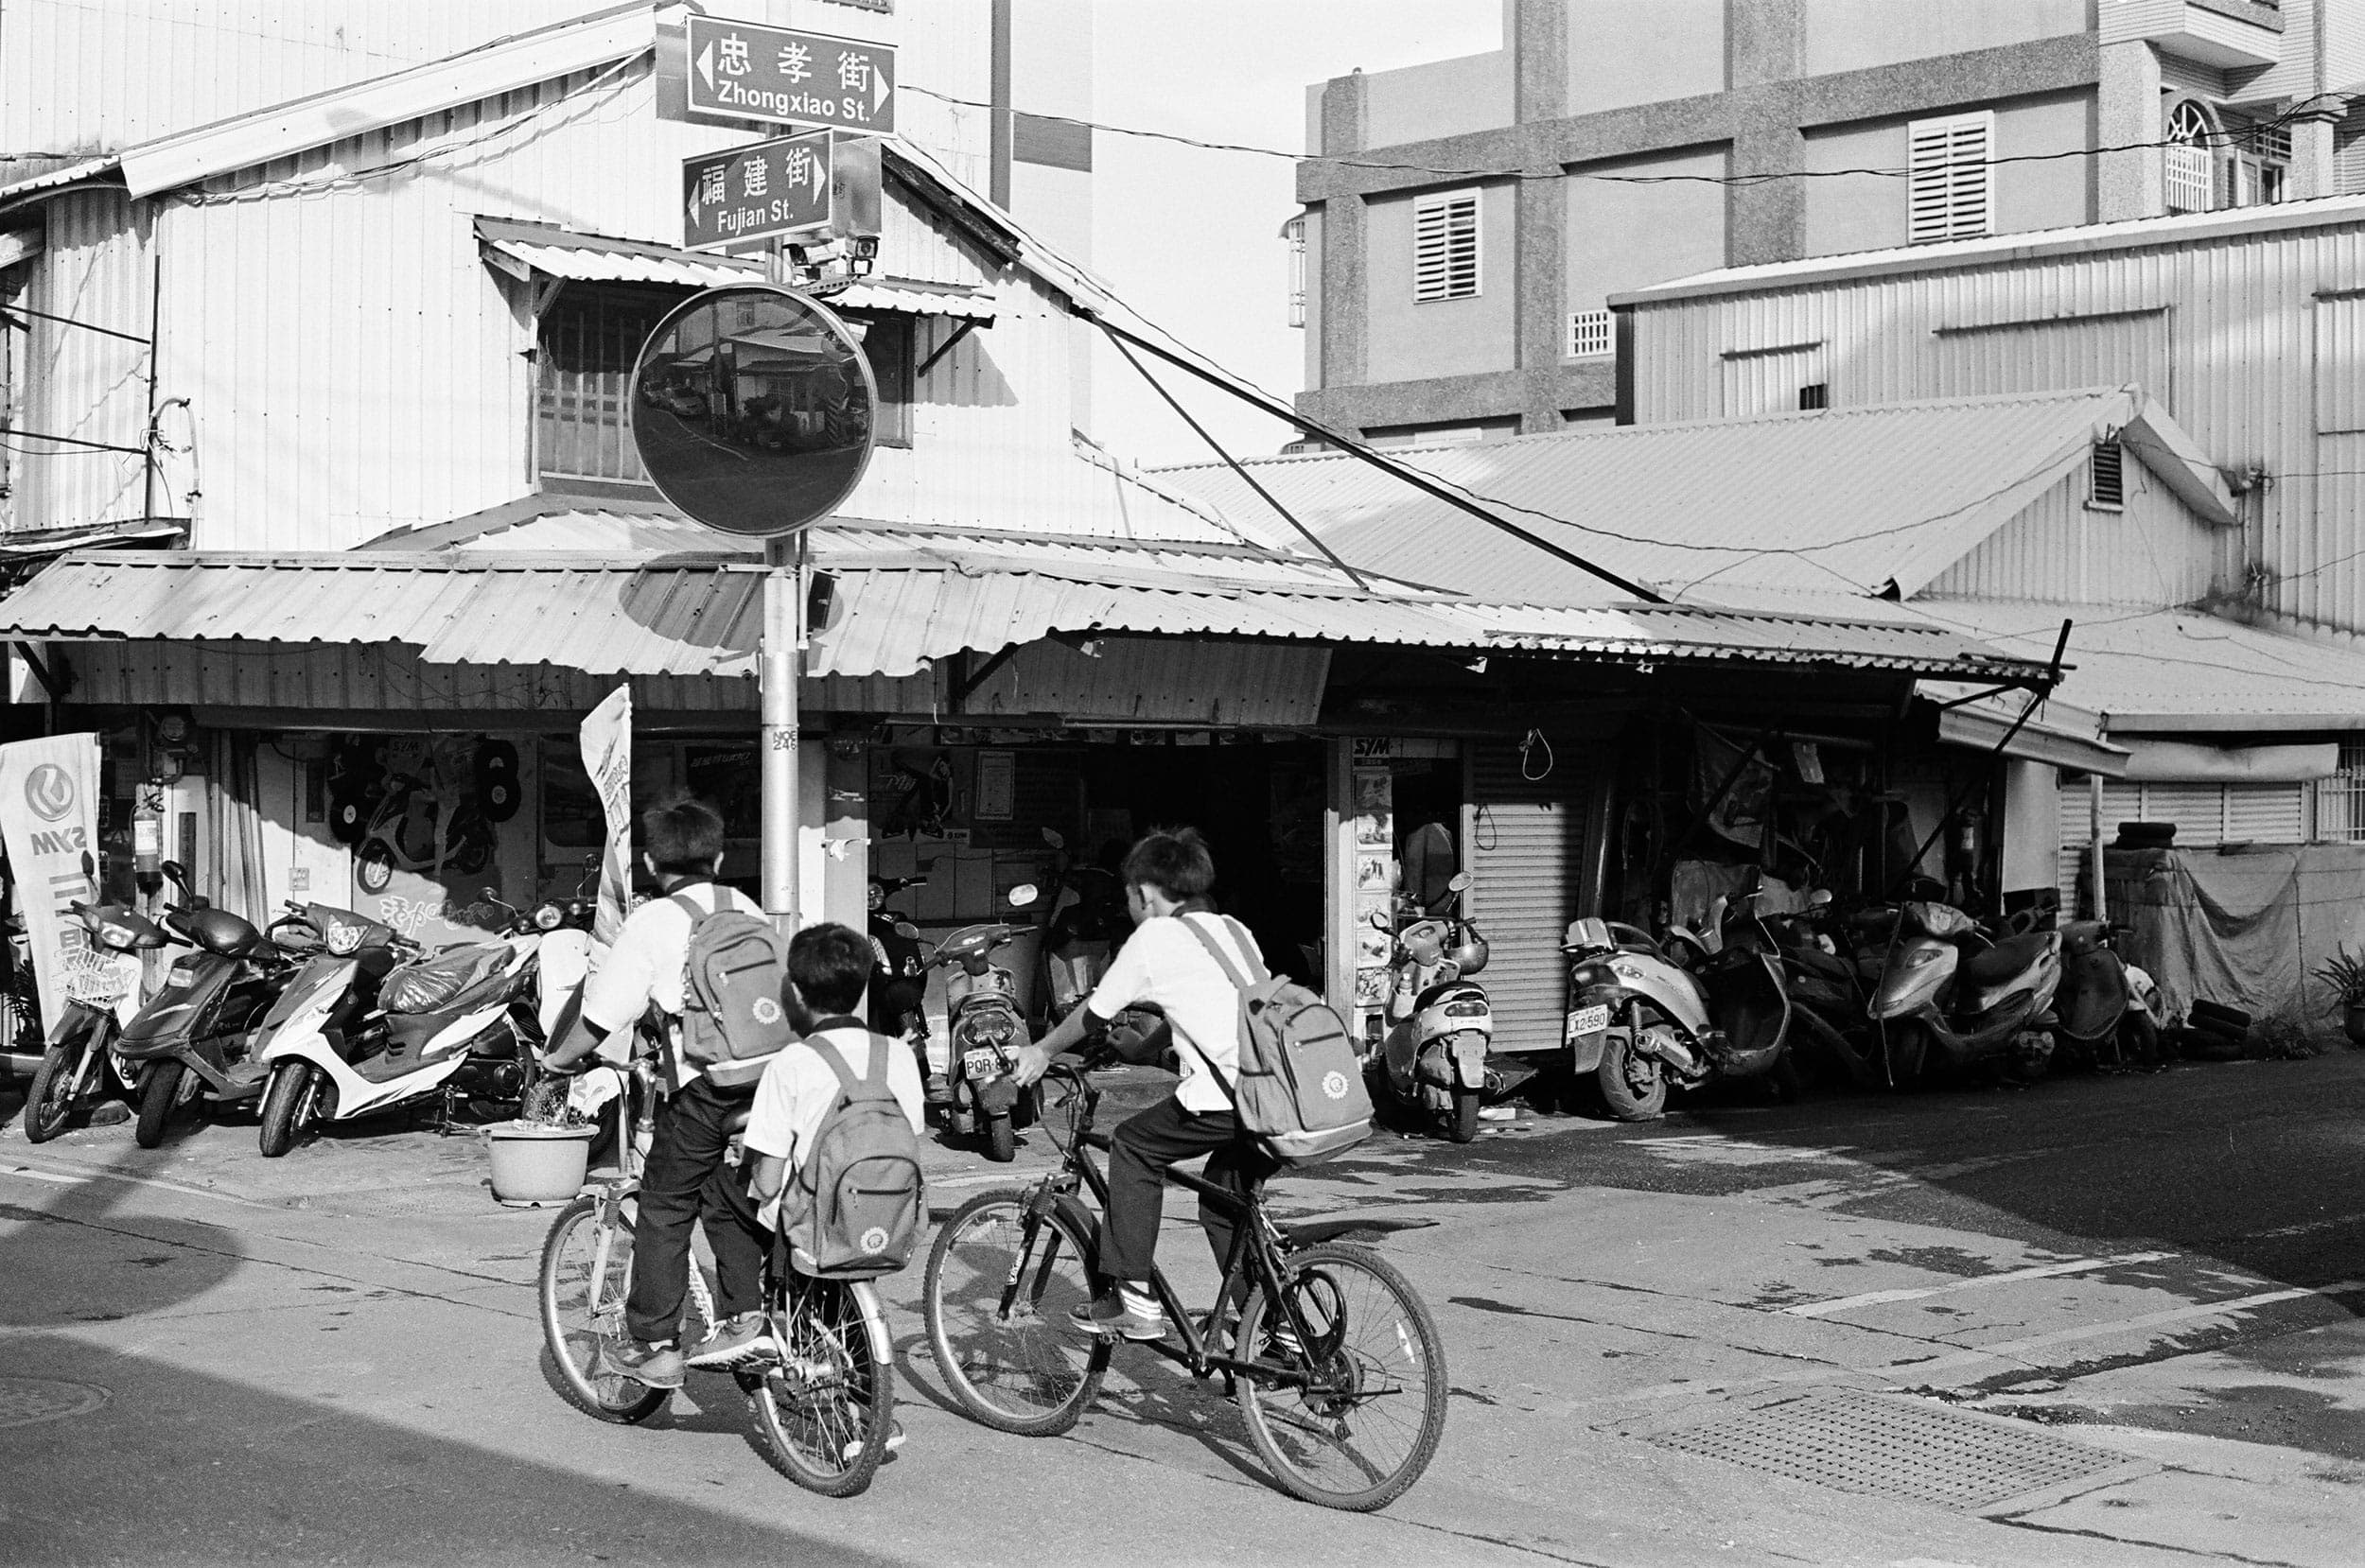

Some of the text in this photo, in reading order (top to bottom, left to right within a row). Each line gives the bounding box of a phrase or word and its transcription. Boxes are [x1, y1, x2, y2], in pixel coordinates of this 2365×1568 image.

[717, 32, 870, 93] 忠孝街
[717, 79, 870, 122] Zhongxiao St.
[701, 147, 811, 206] 福建街
[717, 198, 794, 235] Fujian St.
[1355, 738, 1390, 757] SYM
